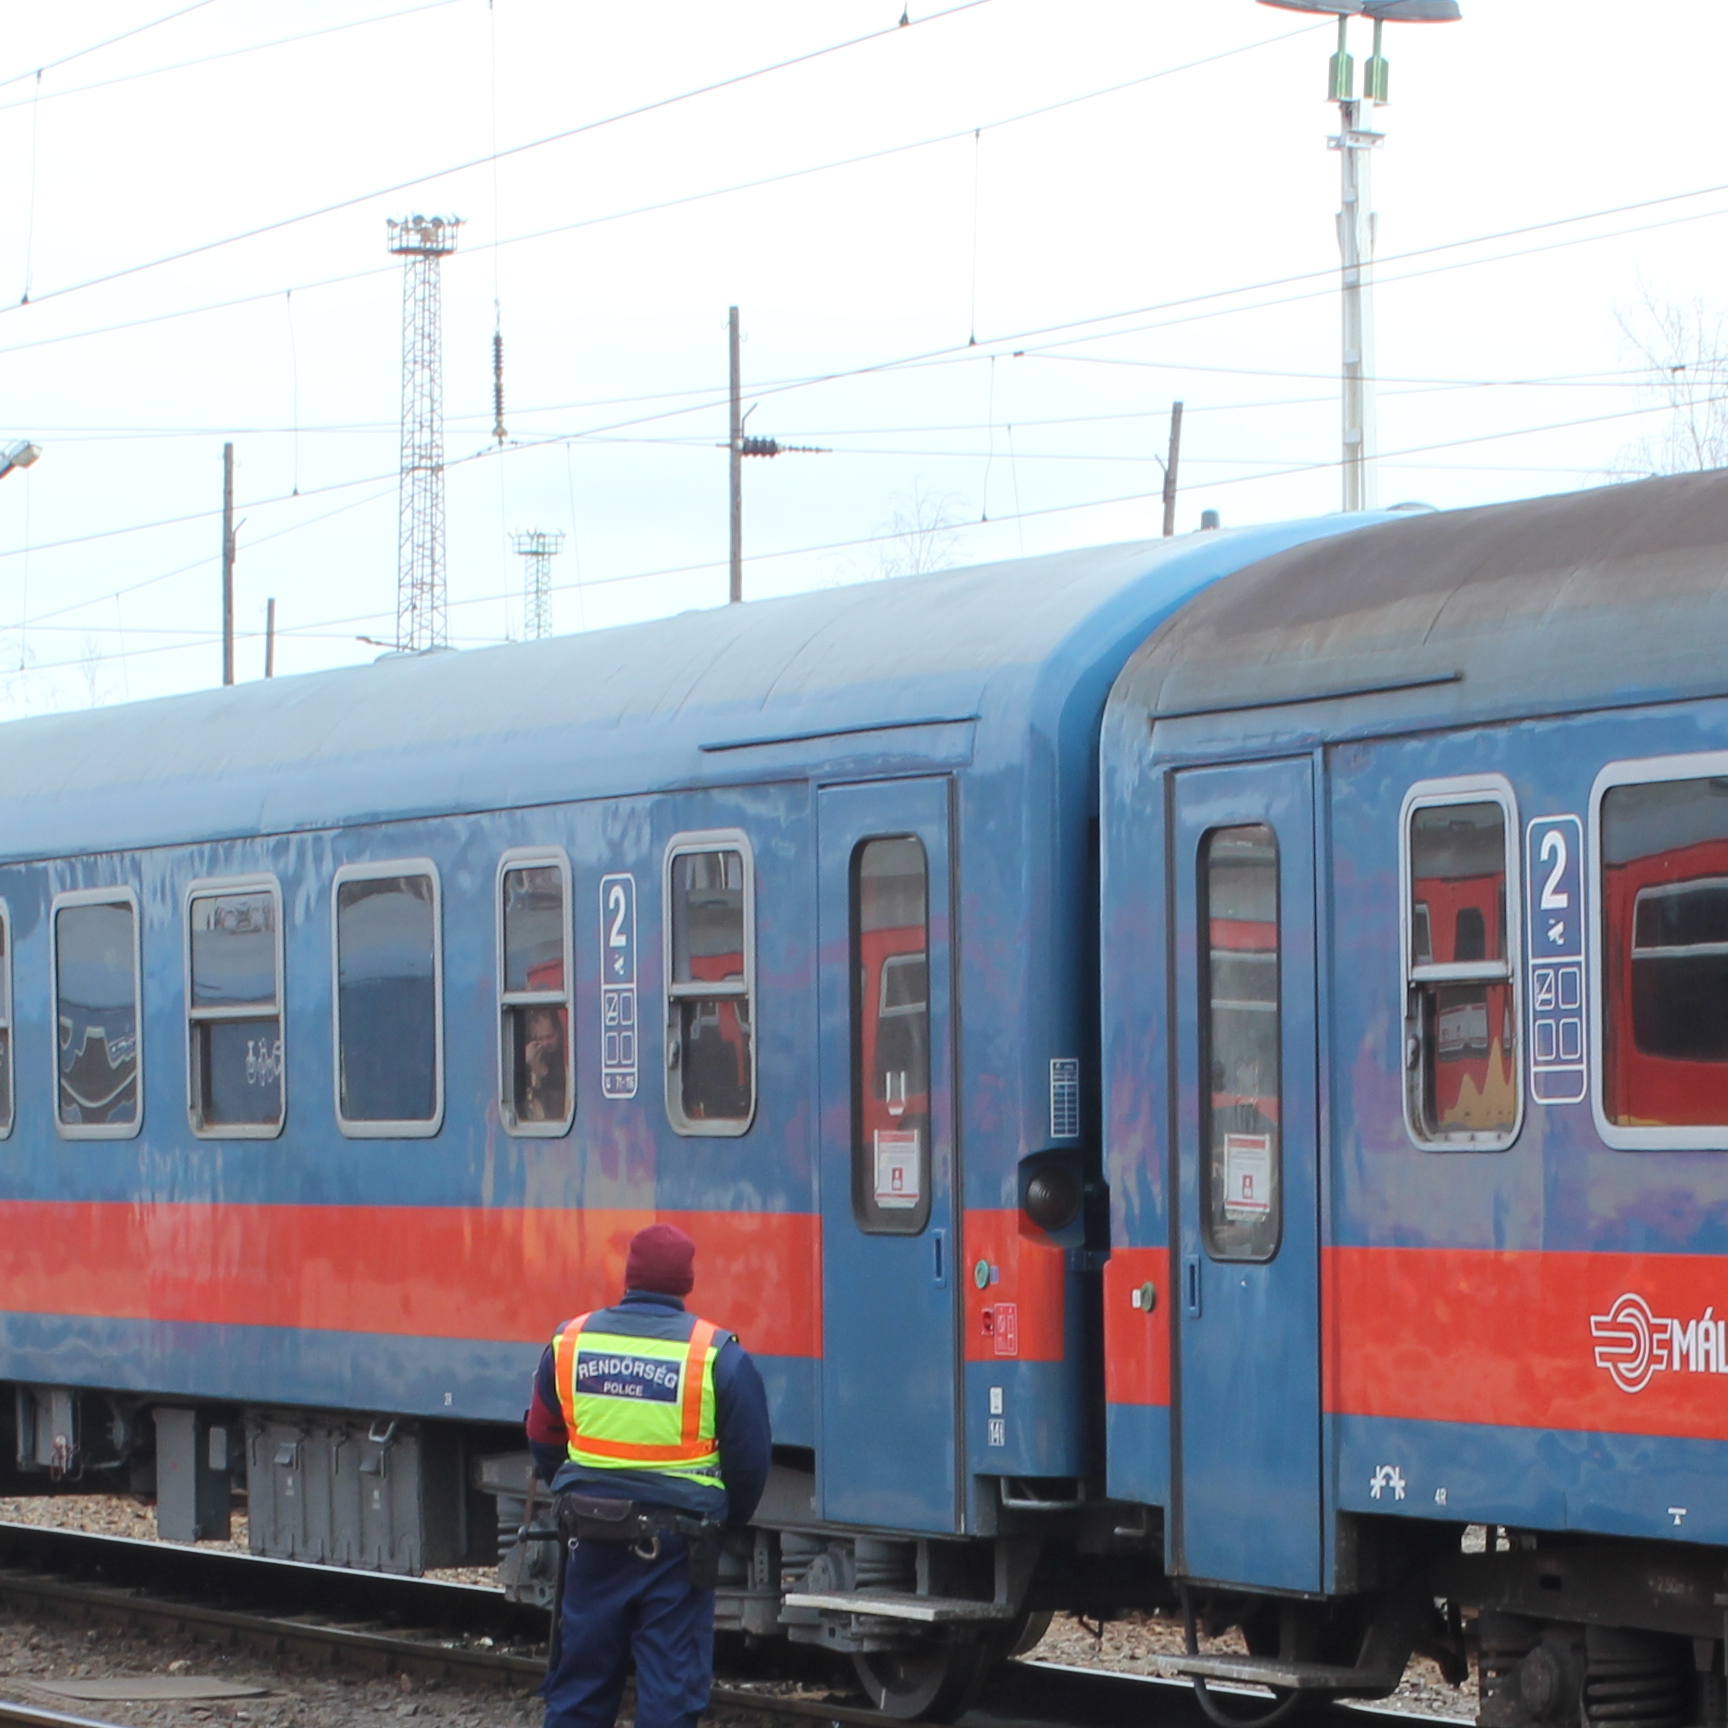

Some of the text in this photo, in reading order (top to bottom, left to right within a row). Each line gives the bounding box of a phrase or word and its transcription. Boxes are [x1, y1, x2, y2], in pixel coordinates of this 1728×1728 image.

[1540, 829, 1568, 910] 2
[608, 884, 627, 947] 2
[578, 1356, 678, 1389] RENDŐRSÉG
[603, 1380, 644, 1397] POLICE
